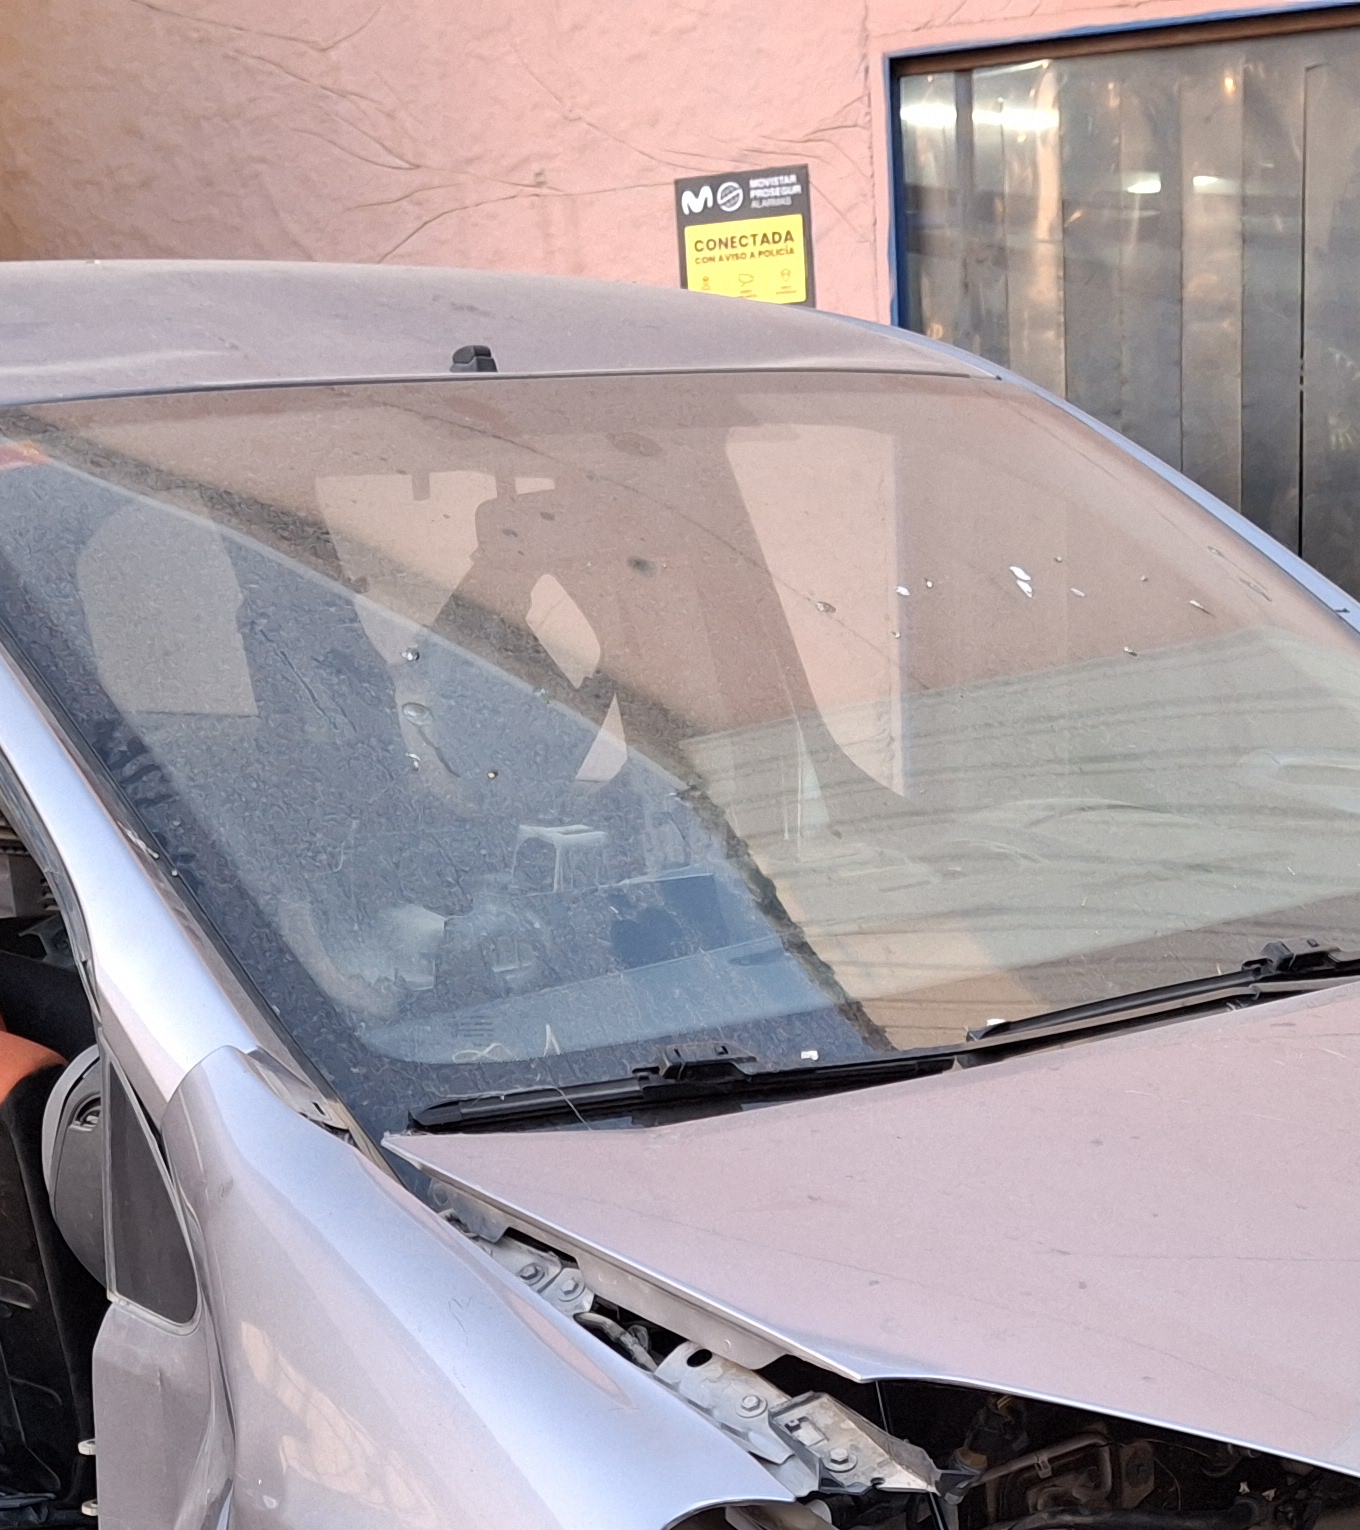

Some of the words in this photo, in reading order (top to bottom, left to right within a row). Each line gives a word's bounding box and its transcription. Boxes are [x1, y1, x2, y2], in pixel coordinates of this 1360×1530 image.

[750, 184, 802, 199] PROSEGUR
[694, 230, 795, 252] CONECTADA
[695, 256, 716, 265] CON
[718, 252, 747, 262] AVISO
[749, 251, 756, 259] A
[758, 245, 795, 258] POLICÍA
